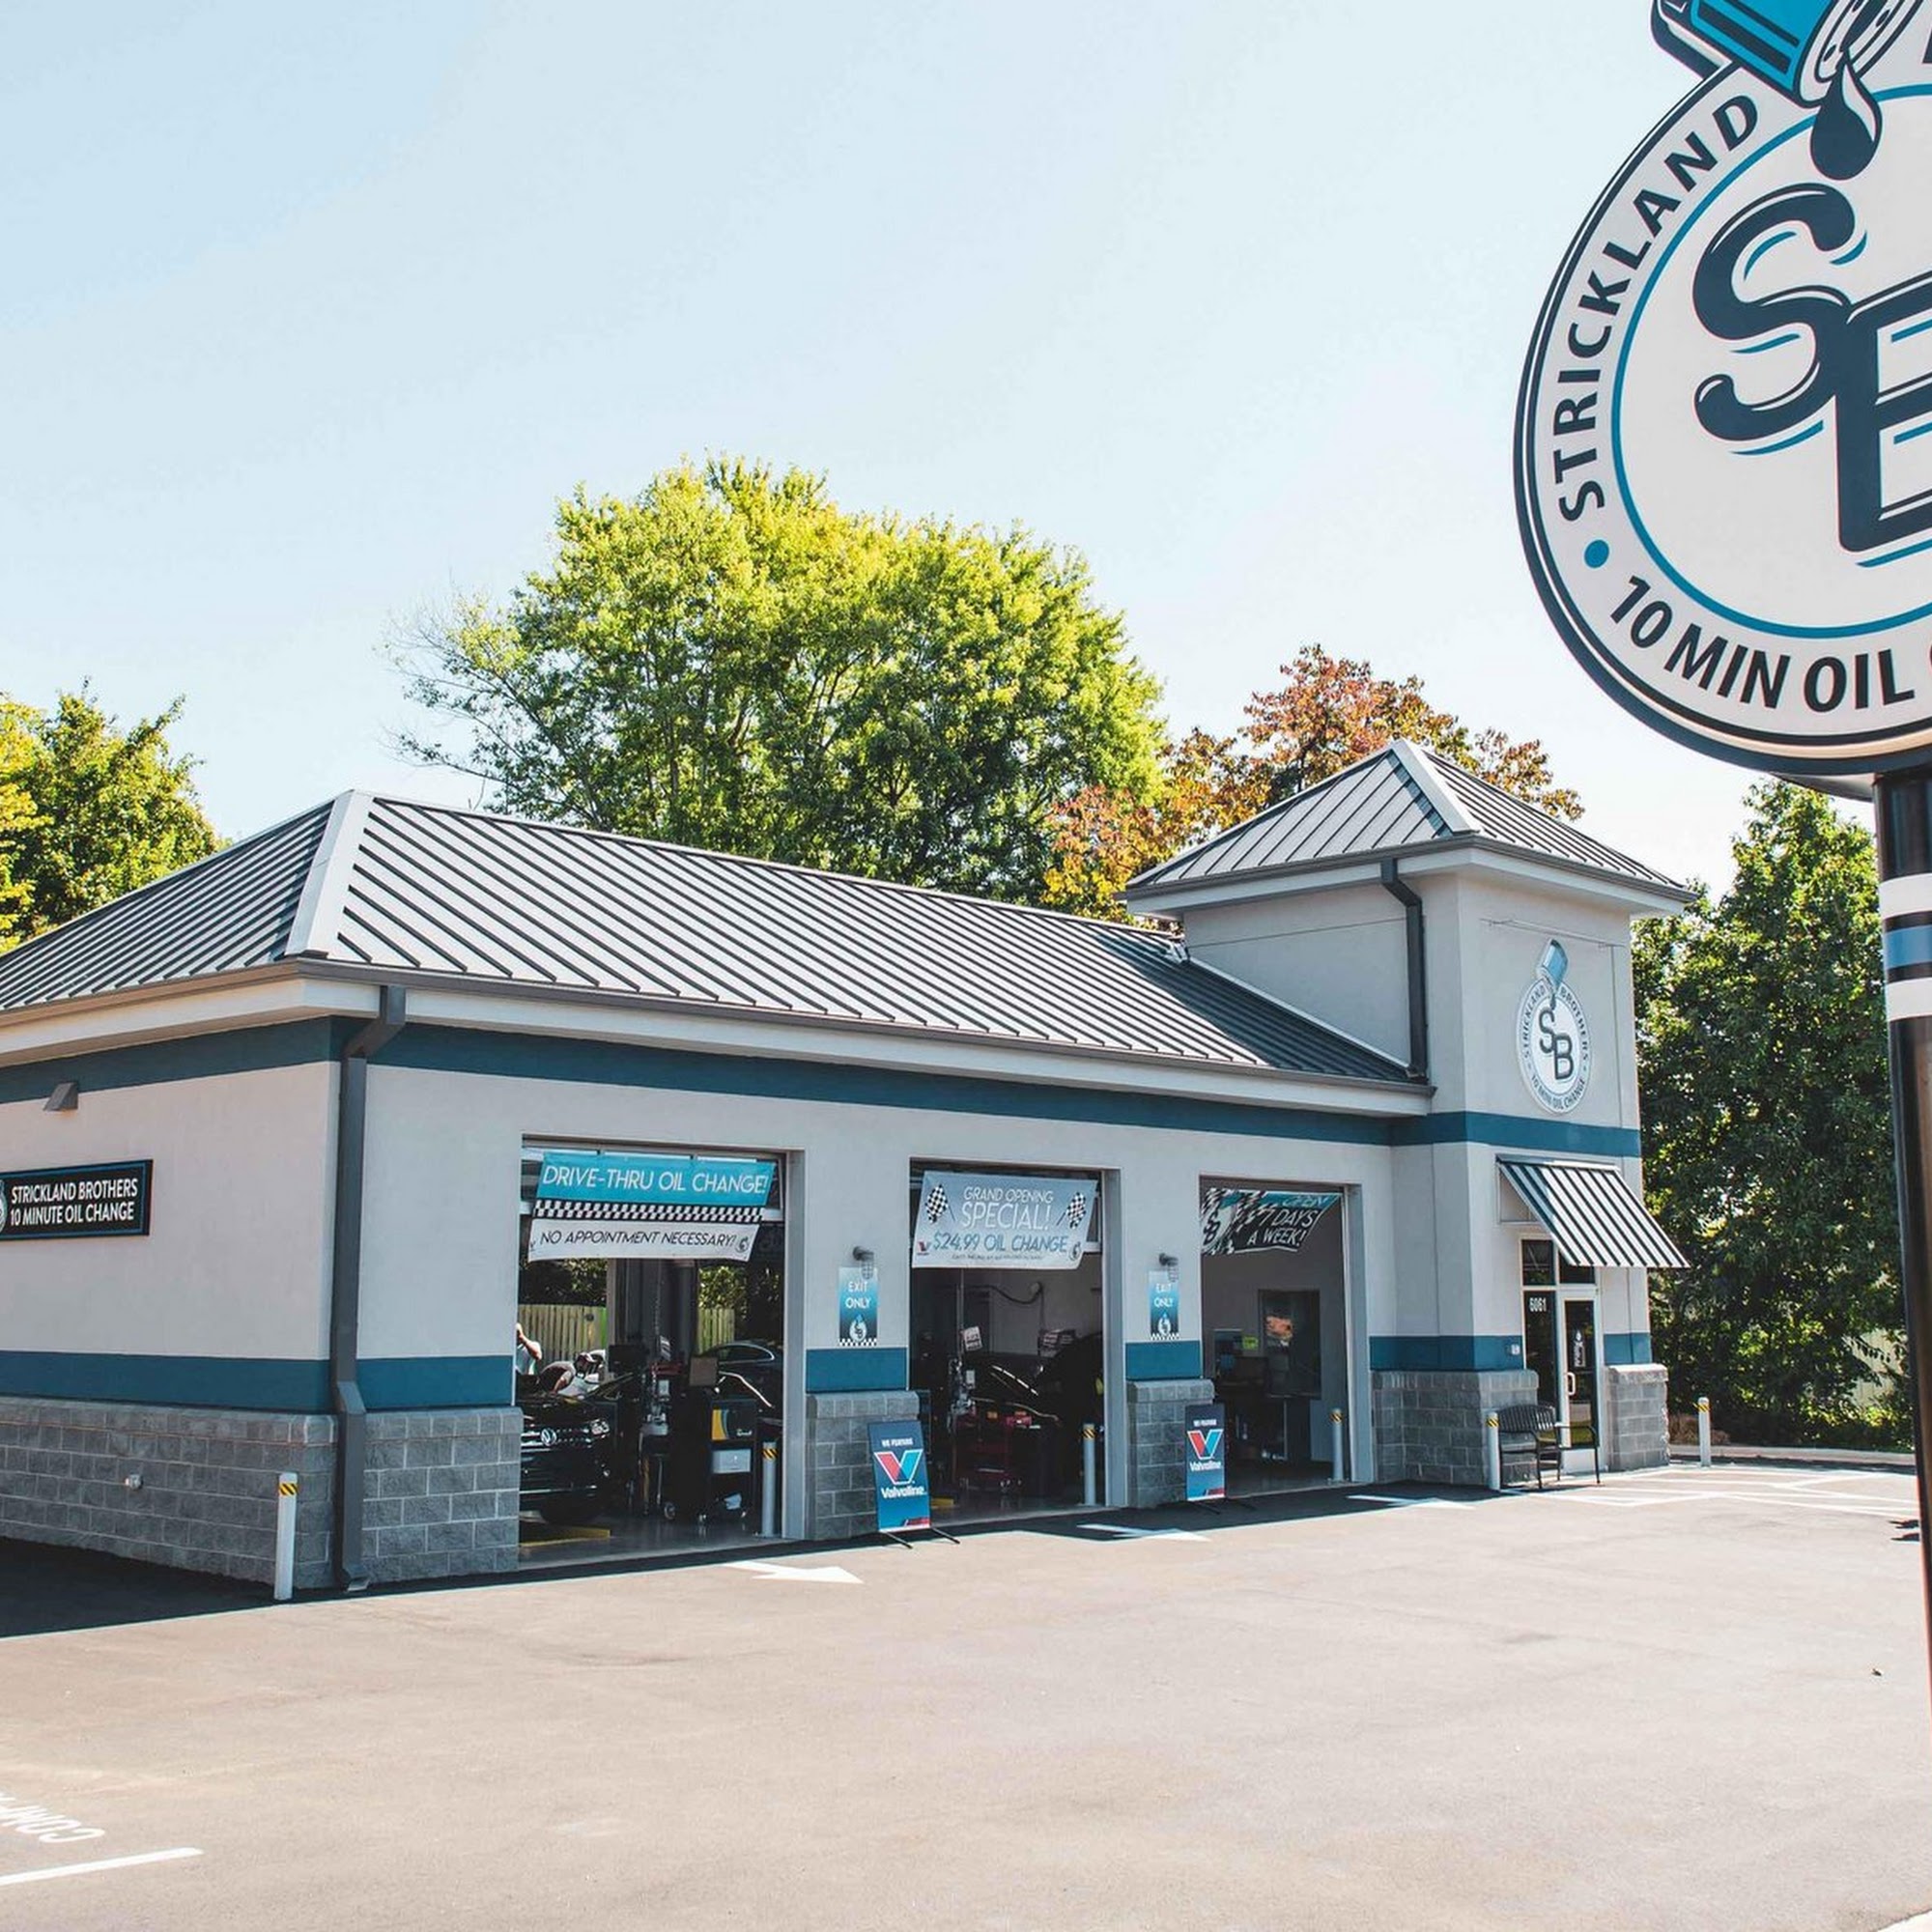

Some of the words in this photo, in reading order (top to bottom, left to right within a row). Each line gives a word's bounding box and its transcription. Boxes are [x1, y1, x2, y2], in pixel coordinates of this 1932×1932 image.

[1552, 95, 1759, 522] STRICKLAND
[1609, 575, 1673, 648] 10
[1663, 623, 1791, 709] MIN
[1804, 648, 1916, 713] OIL
[1520, 984, 1547, 1059] STRICKLAND
[1559, 985, 1589, 1061] BROTHERS
[1539, 1009, 1575, 1080] SB
[1563, 1079, 1586, 1108] CHANGE
[12, 1182, 76, 1204] STRICKLAND
[78, 1179, 138, 1200] BROTHERS
[543, 1166, 654, 1189] DRIVE-THRU
[659, 1171, 686, 1192] OIL
[692, 1174, 769, 1194] CHANGE!
[963, 1186, 1004, 1202] GRAND
[1005, 1188, 1054, 1204] OPENING
[1282, 1196, 1328, 1208] OPEN
[11, 1208, 20, 1226] 10
[22, 1206, 64, 1226] MINUTE
[65, 1205, 84, 1223] OIL
[85, 1201, 135, 1221] CHANGE
[961, 1201, 1051, 1231] SPECIAL!
[1259, 1208, 1276, 1227] 7
[1271, 1209, 1318, 1228] DAYS
[540, 1231, 562, 1244] NO
[564, 1230, 660, 1244] APPOINTMENT
[661, 1233, 737, 1247] NECESSARY!
[932, 1232, 980, 1251] $24.99
[983, 1235, 1006, 1252] OIL
[1011, 1236, 1069, 1253] CHANGE
[1247, 1231, 1257, 1246] A
[1263, 1228, 1306, 1247] WEEK!
[848, 1281, 868, 1293] EXIT
[845, 1296, 871, 1309] ONLY
[1189, 1460, 1222, 1471] Valvoline
[881, 1485, 925, 1499] Valvoline
